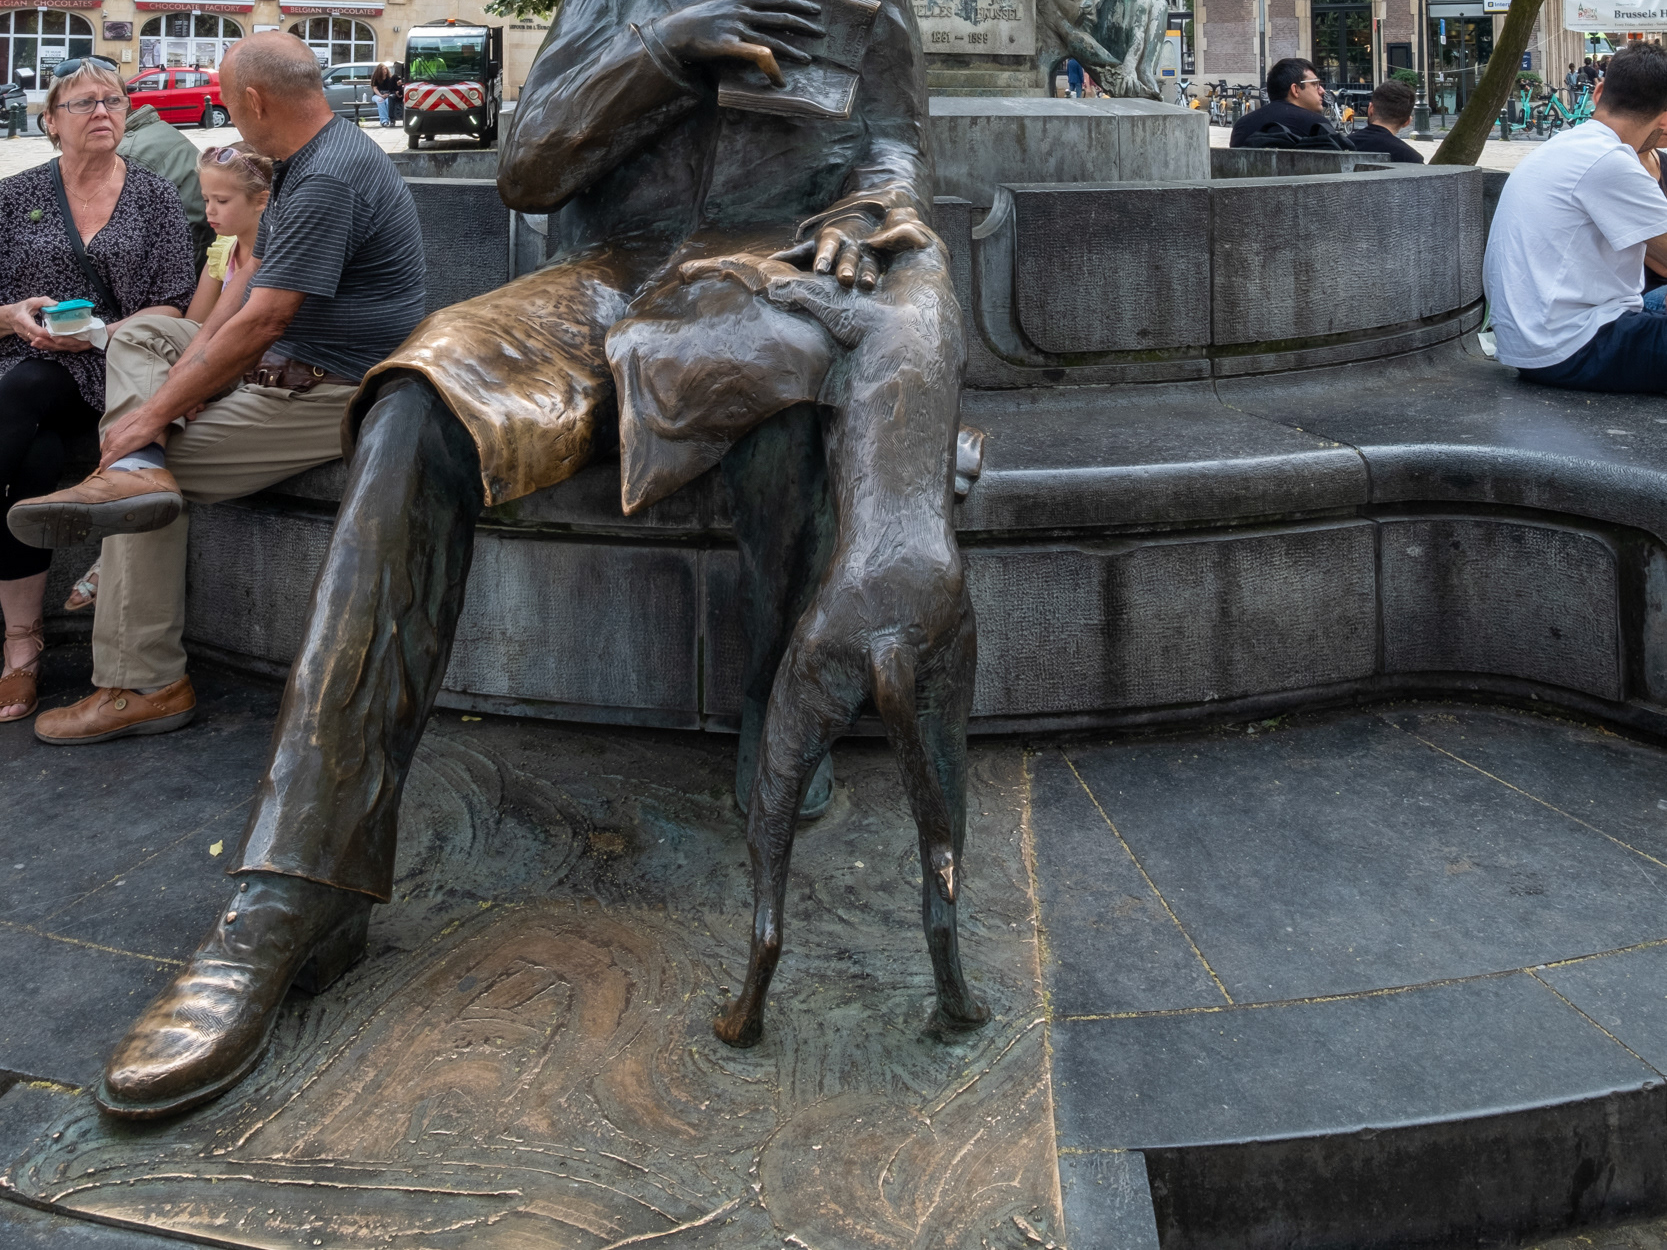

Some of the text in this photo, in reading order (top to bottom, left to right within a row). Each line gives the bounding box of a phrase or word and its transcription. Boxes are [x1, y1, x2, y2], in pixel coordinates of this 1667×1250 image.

[149, 2, 241, 12] CHOCOLATE FACTORY
[290, 6, 376, 15] BELGIAN CHOCOLATES
[1614, 10, 1657, 19] Brussels
